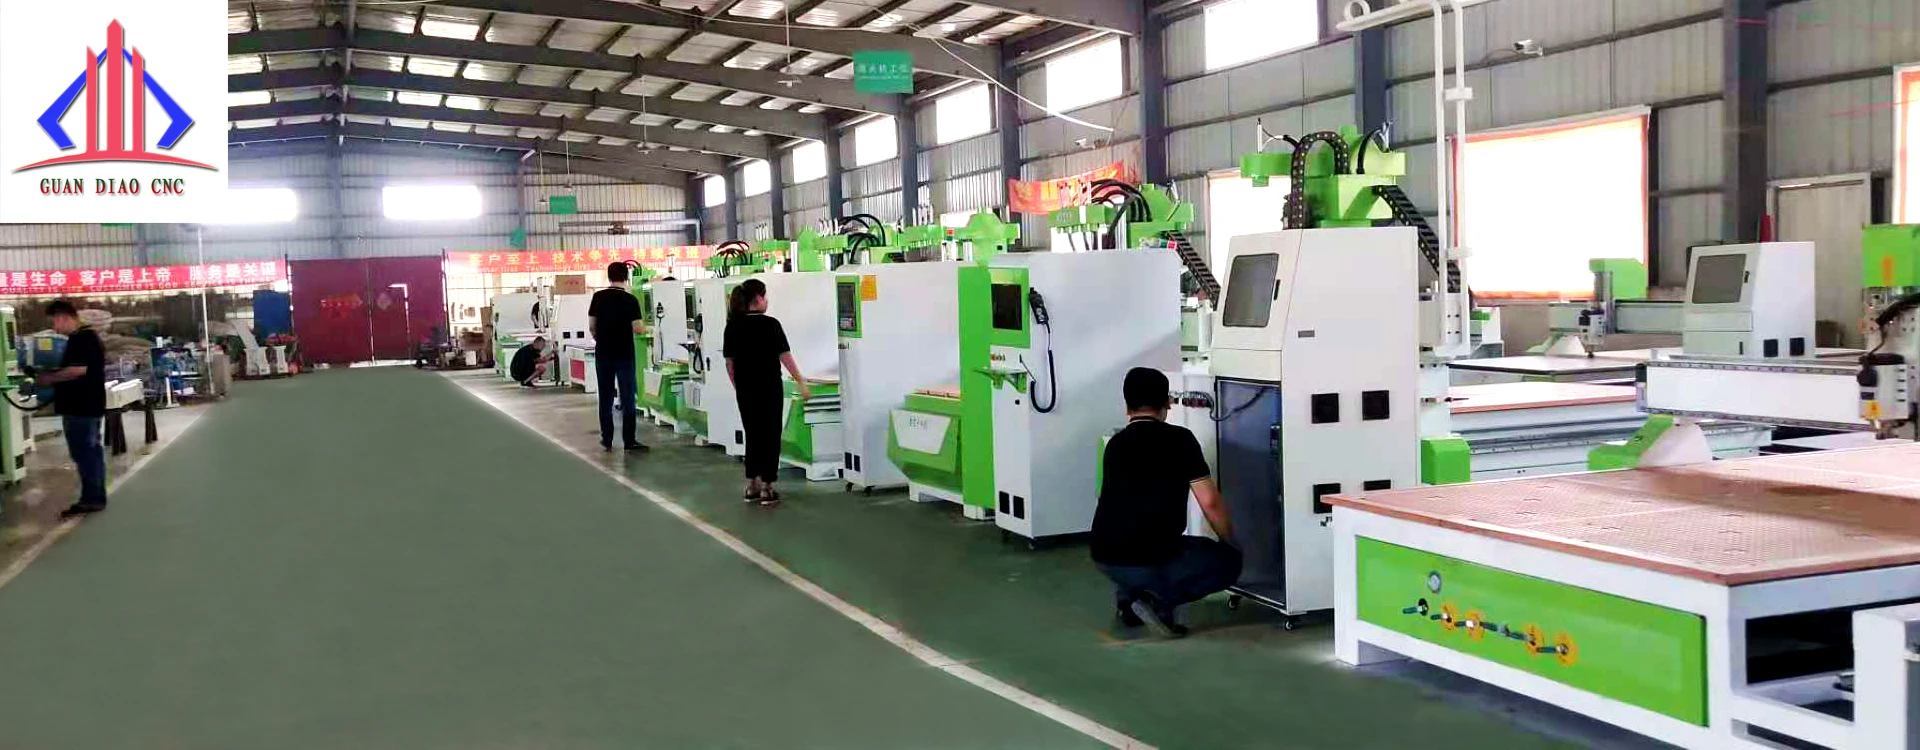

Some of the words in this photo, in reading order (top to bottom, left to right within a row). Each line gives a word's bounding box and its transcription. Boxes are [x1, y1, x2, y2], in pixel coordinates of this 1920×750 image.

[80, 267, 172, 286] 客户是上帝
